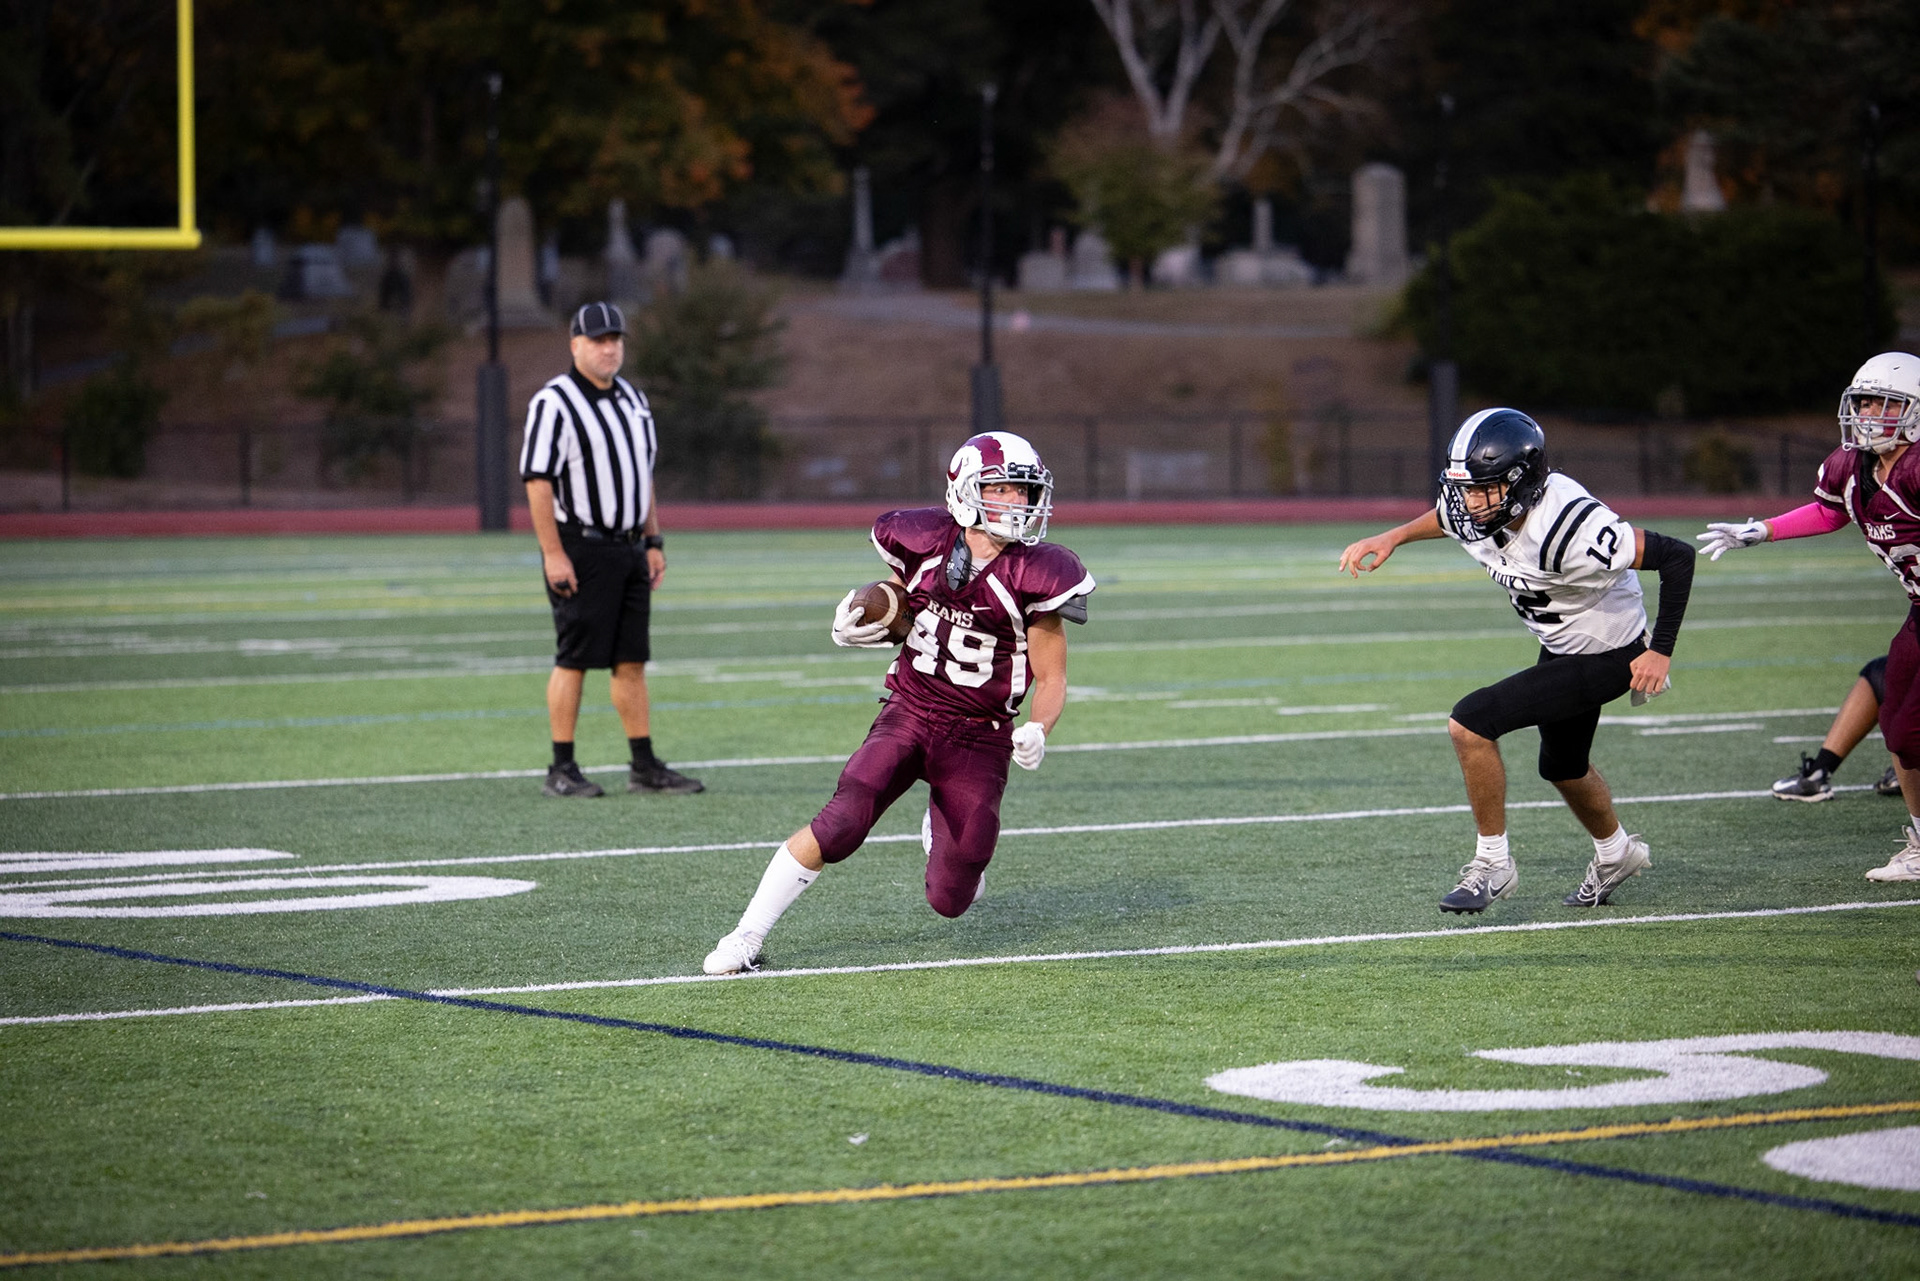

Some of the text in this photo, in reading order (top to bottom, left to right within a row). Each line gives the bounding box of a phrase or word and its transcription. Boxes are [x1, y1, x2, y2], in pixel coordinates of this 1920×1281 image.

[1586, 525, 1617, 570] 12
[1864, 522, 1896, 540] RAMS
[926, 599, 974, 628] RAMS
[906, 608, 998, 688] 49
